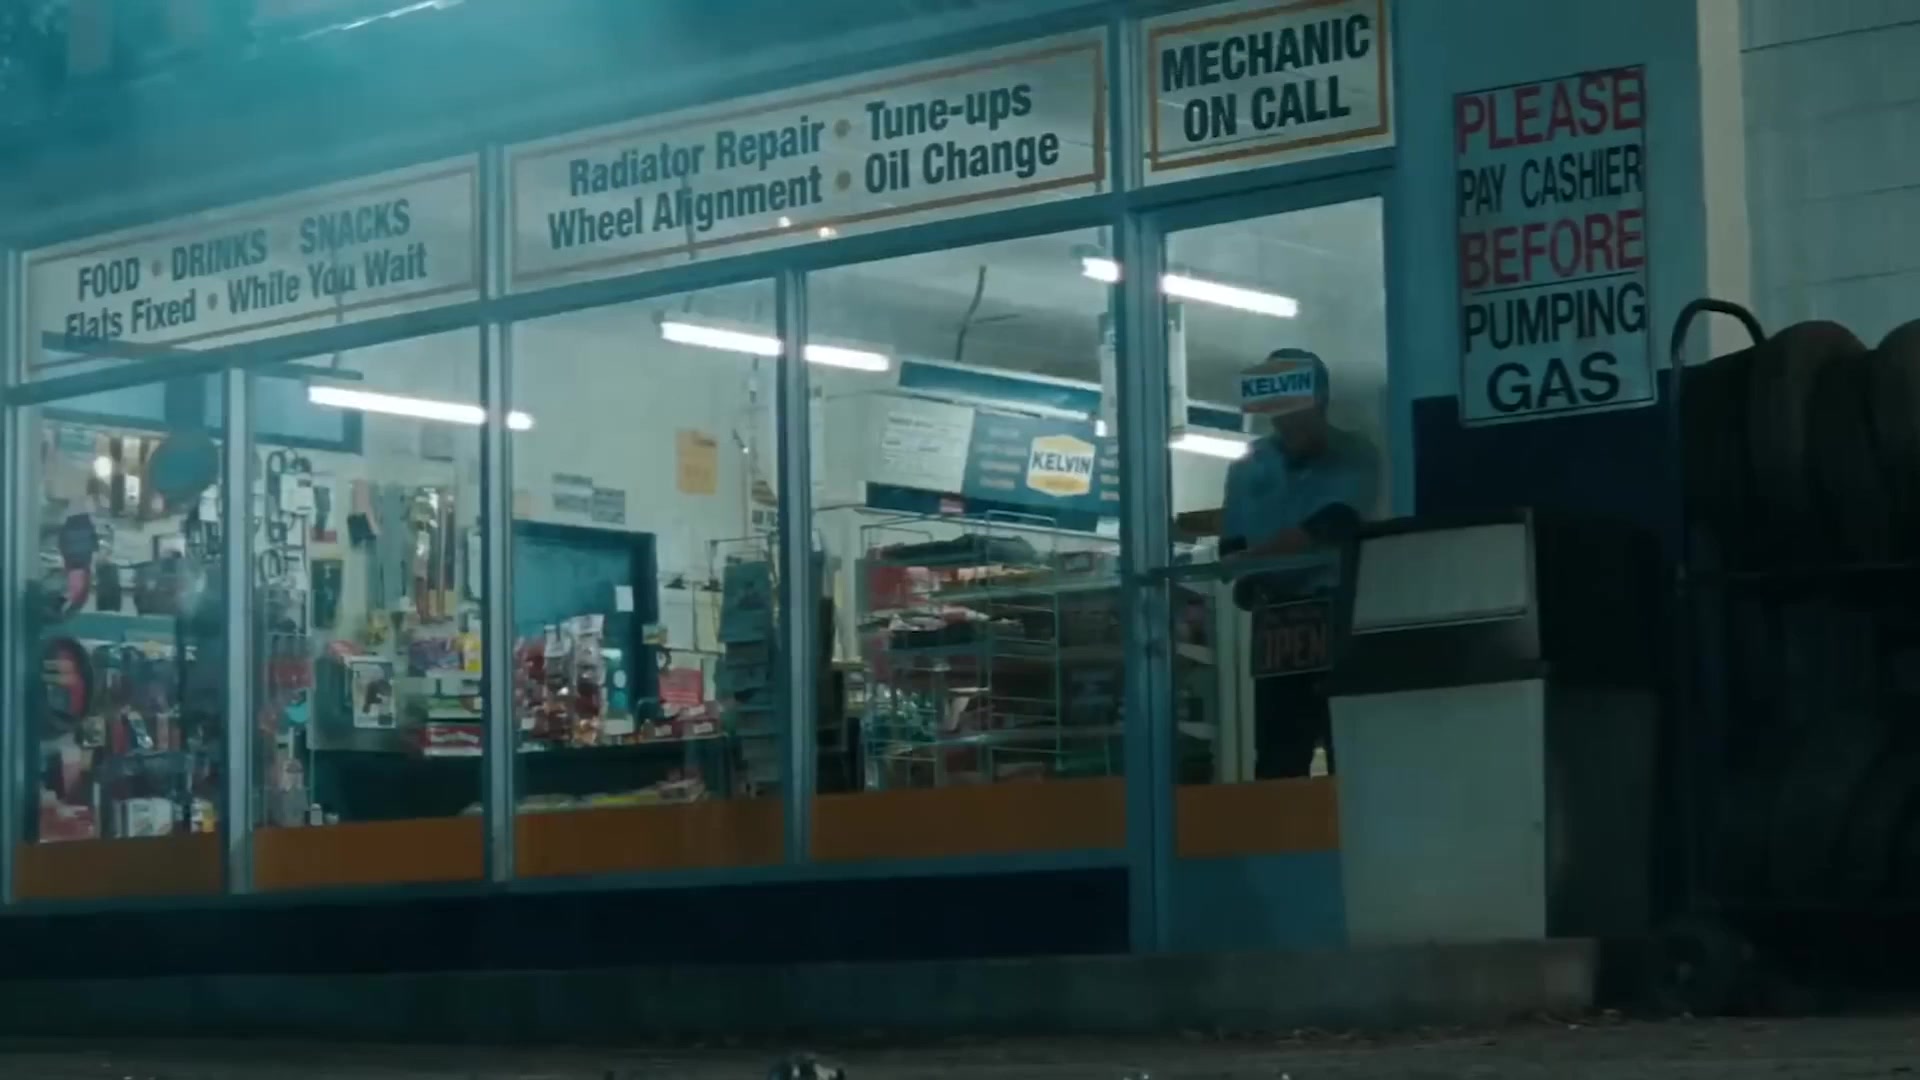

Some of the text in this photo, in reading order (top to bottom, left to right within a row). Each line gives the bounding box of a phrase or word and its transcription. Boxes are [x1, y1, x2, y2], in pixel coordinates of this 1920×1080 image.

[1161, 13, 1370, 92] MECHANIC
[569, 82, 1032, 197] Radiator Repair Tune-ups
[1184, 75, 1351, 142] ON CALL
[1456, 68, 1645, 154] PLEASE
[547, 131, 1060, 250] Wheel Alignment Oil Change
[1460, 144, 1645, 217] PAY CASHIER
[78, 197, 410, 302] FOOD DRINKS SNACKS
[131, 288, 197, 334] Fixed
[227, 269, 299, 314] While
[307, 260, 357, 298] You
[363, 242, 427, 288] Wait
[1460, 208, 1645, 290] BEFORE
[1464, 282, 1646, 353] PUMPING
[1241, 371, 1312, 398] KELVIN
[1486, 351, 1620, 413] GAS
[1031, 452, 1092, 474] KELVIN
